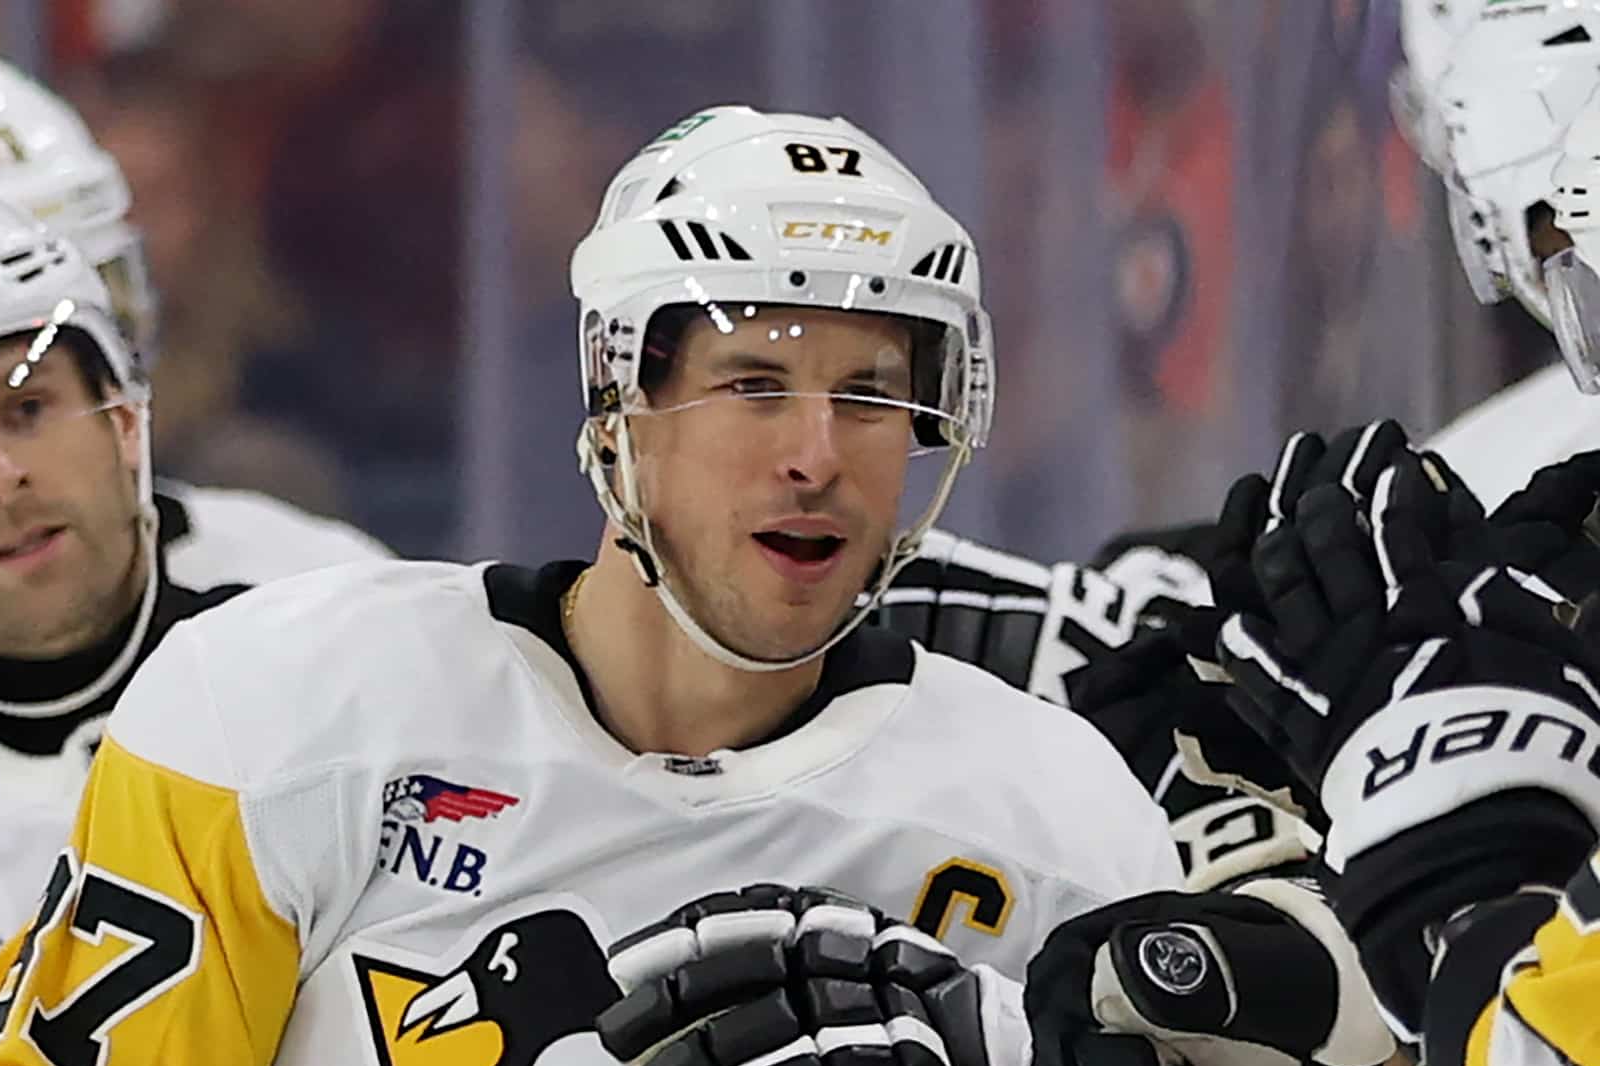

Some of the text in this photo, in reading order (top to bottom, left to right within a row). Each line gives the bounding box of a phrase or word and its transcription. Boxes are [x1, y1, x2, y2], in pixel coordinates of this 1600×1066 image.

[784, 142, 864, 177] 87
[782, 220, 893, 247] CCM
[907, 858, 1014, 940] C
